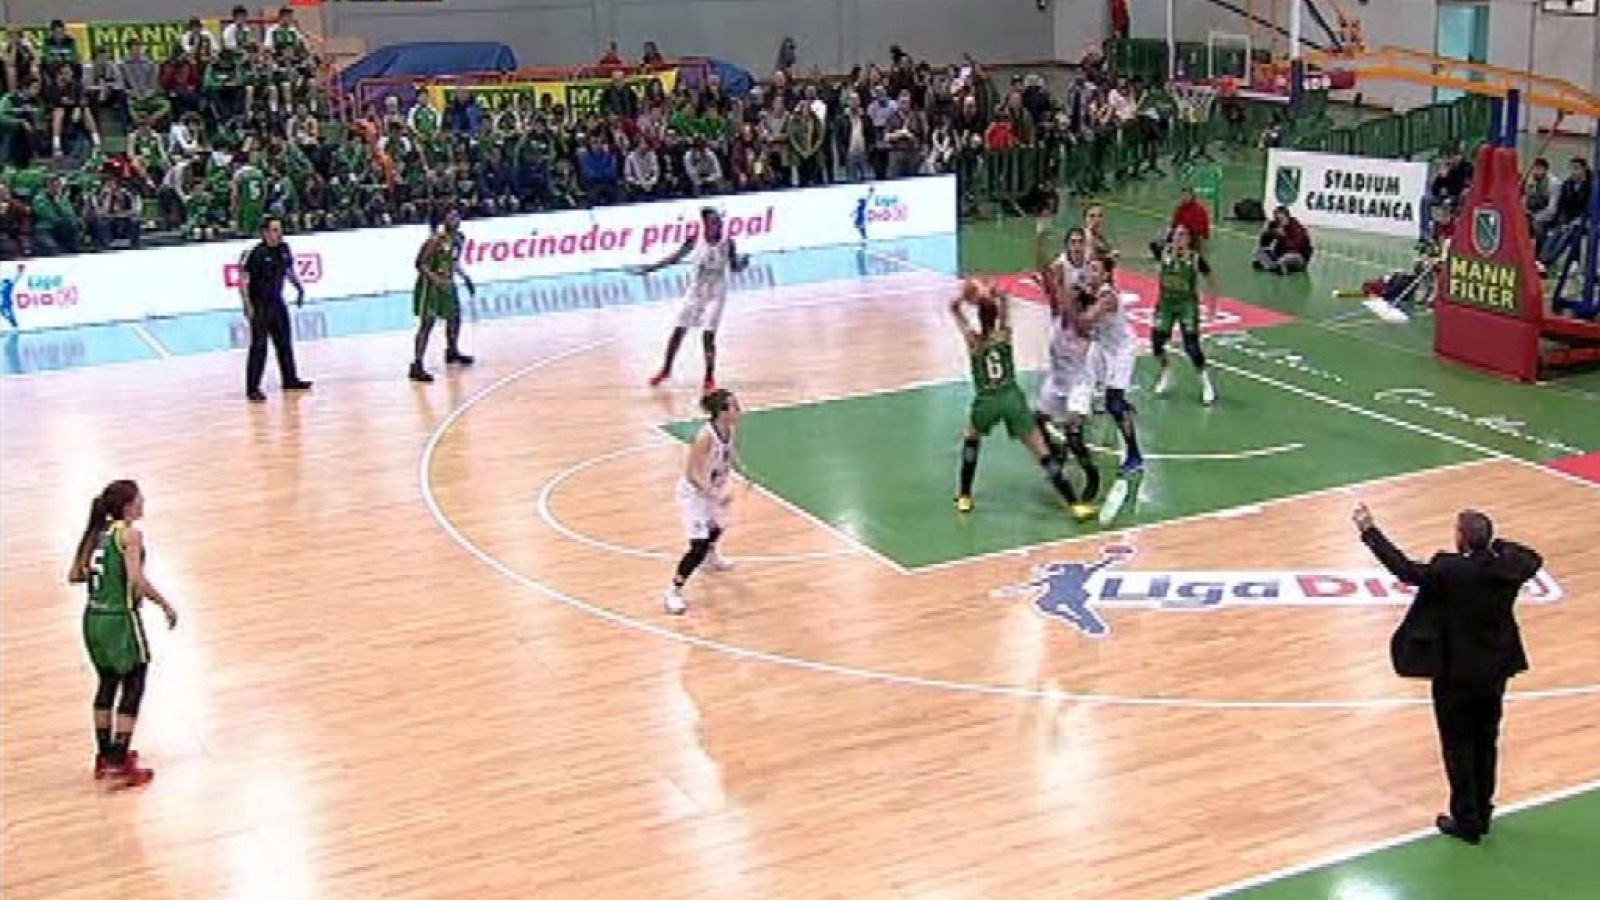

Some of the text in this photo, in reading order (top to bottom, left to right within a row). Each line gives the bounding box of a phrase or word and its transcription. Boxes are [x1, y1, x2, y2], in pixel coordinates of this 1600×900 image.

[94, 25, 183, 46] MANN
[1324, 168, 1401, 196] STADIUM
[1304, 190, 1415, 221] CASABLANCA
[640, 205, 775, 254] prinpal
[1449, 256, 1517, 288] MANN
[1449, 278, 1515, 311] FILTER
[986, 350, 1004, 379] 6
[1097, 574, 1281, 608] Liga
